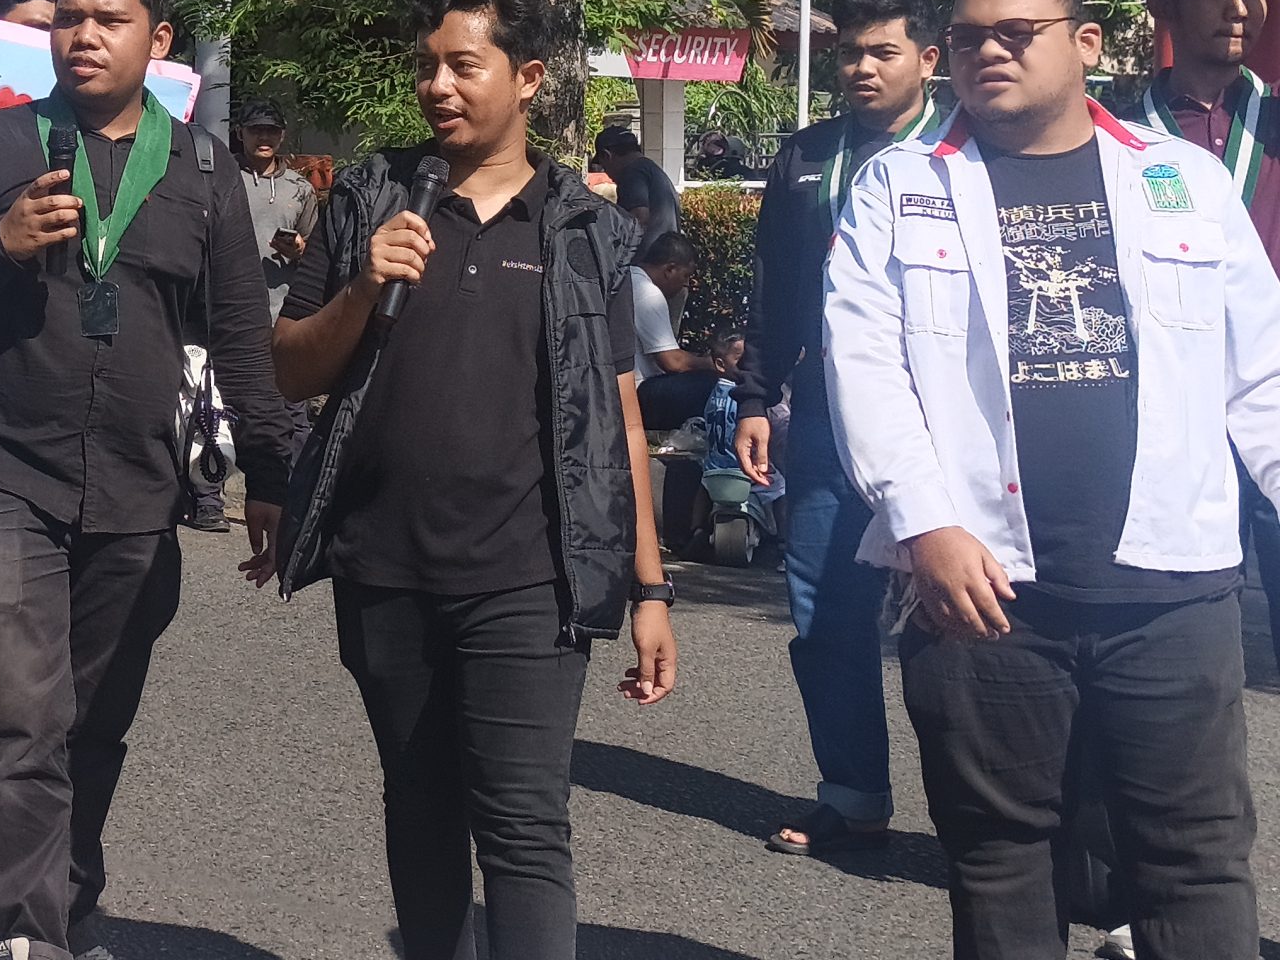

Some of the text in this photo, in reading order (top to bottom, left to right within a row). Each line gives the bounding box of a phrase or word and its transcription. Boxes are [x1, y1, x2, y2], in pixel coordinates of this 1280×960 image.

[634, 33, 739, 66] SECURITY
[1010, 358, 1130, 383] よこはまし
